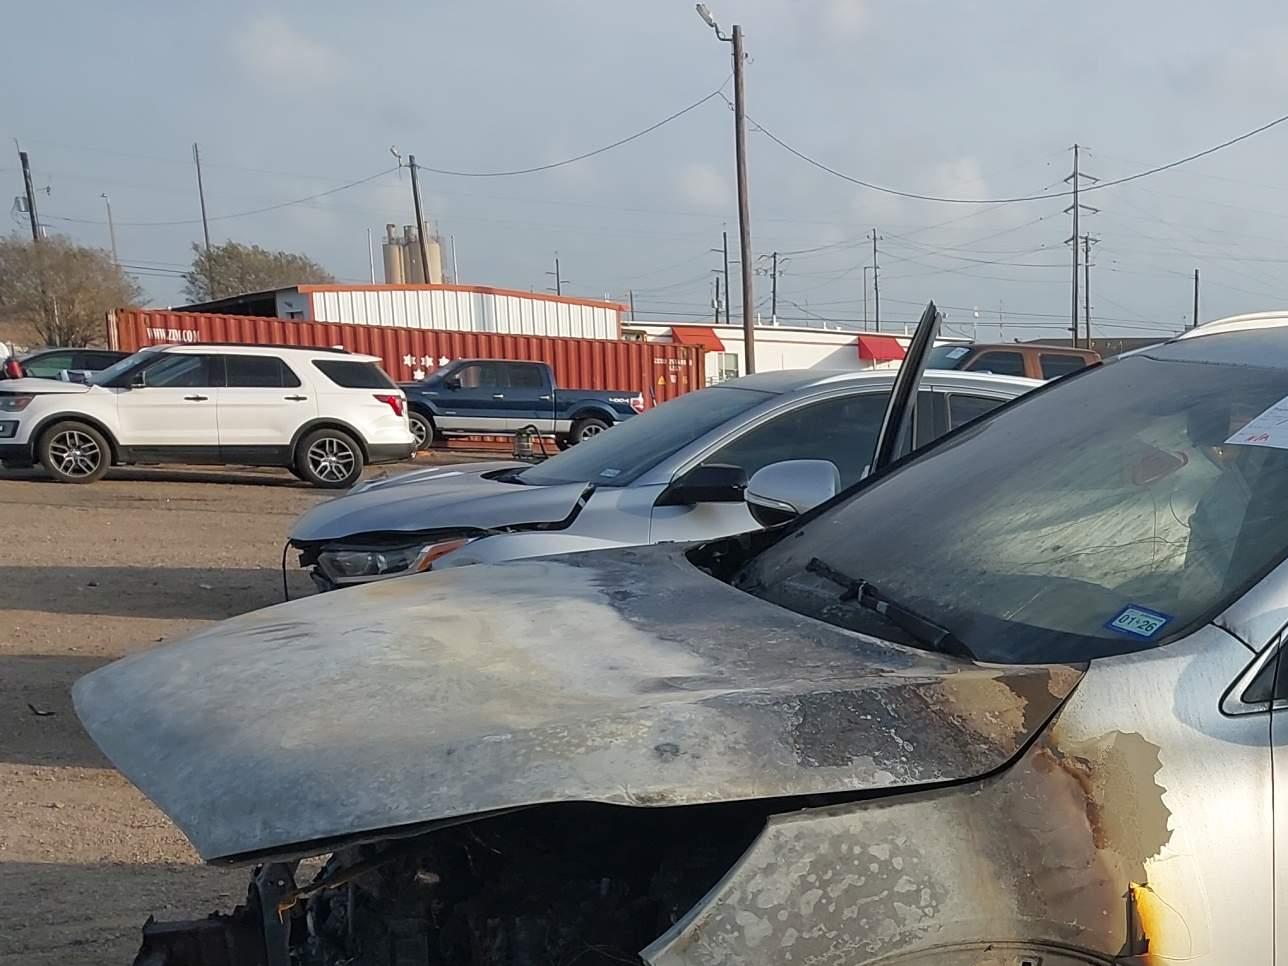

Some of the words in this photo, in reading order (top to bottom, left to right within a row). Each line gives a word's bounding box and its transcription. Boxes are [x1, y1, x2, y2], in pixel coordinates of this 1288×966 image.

[146, 327, 201, 343] WWW.ZIM.COM
[1118, 614, 1137, 626] 01
[1137, 620, 1158, 633] 26
